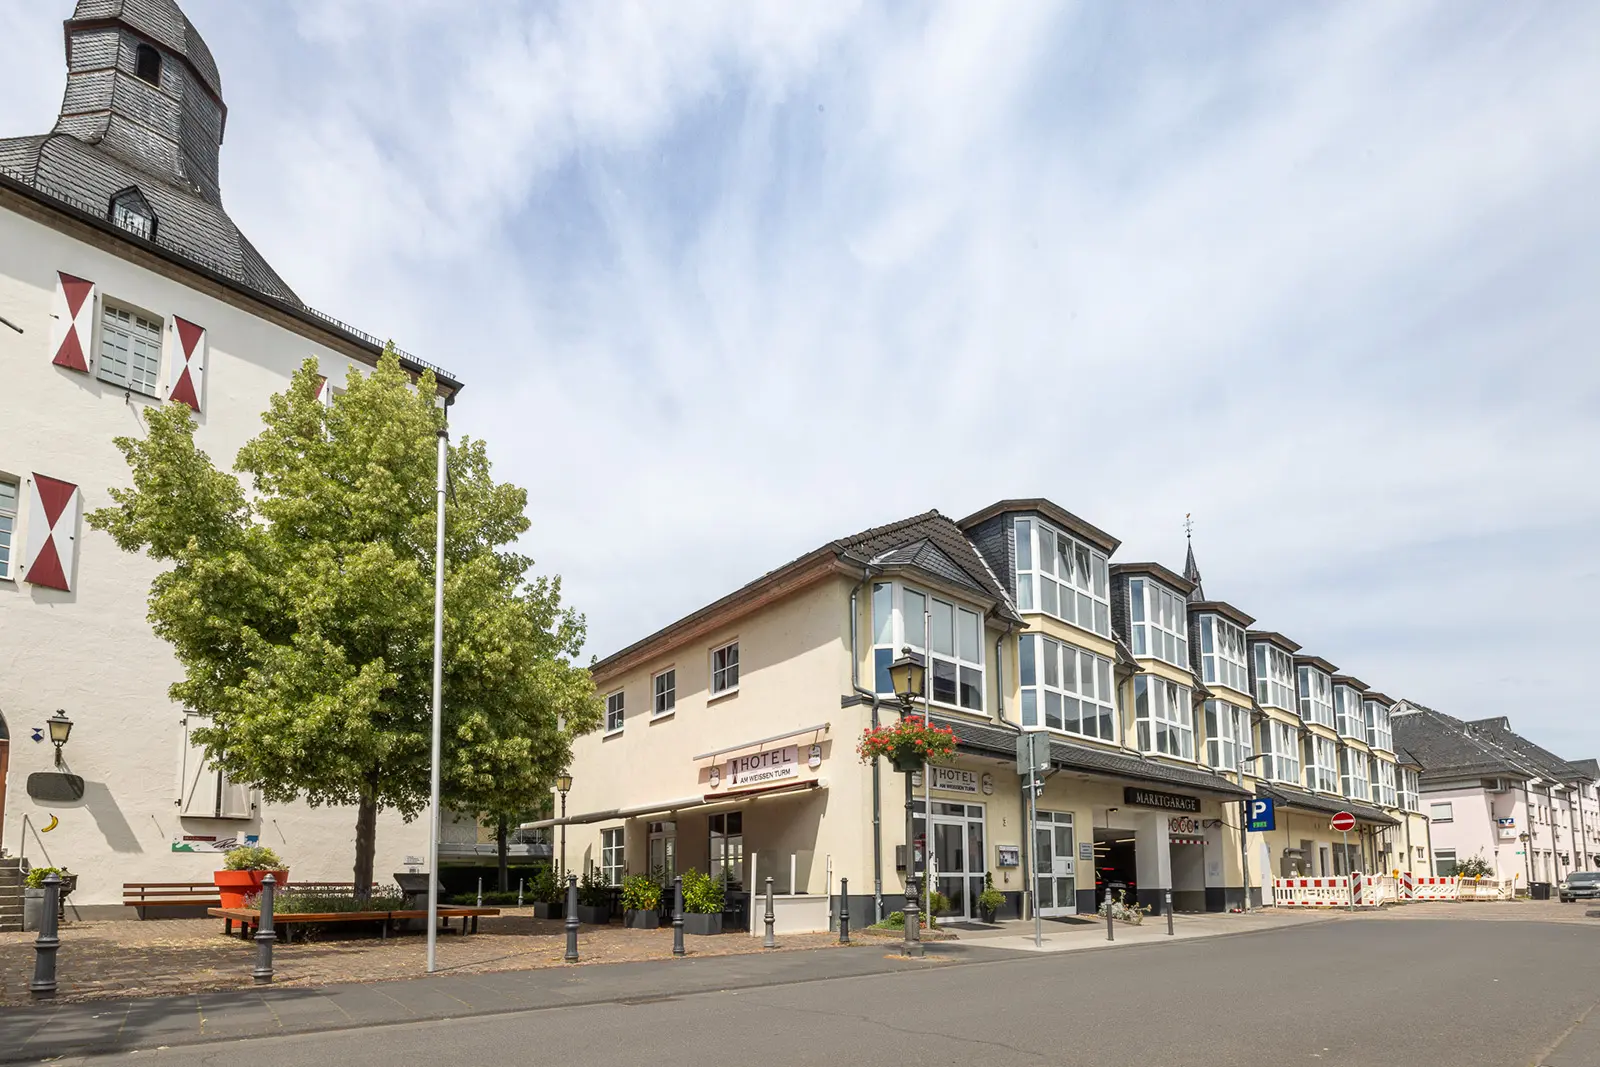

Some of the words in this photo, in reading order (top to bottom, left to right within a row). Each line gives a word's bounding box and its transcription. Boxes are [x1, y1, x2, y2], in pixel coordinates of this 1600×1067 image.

[741, 749, 791, 771] HOTEL
[749, 771, 774, 781] WEISSEN
[774, 768, 791, 777] TURM
[939, 769, 976, 783] HOTEL
[1136, 792, 1196, 811] MARKTGARAGE
[1251, 801, 1267, 820] P
